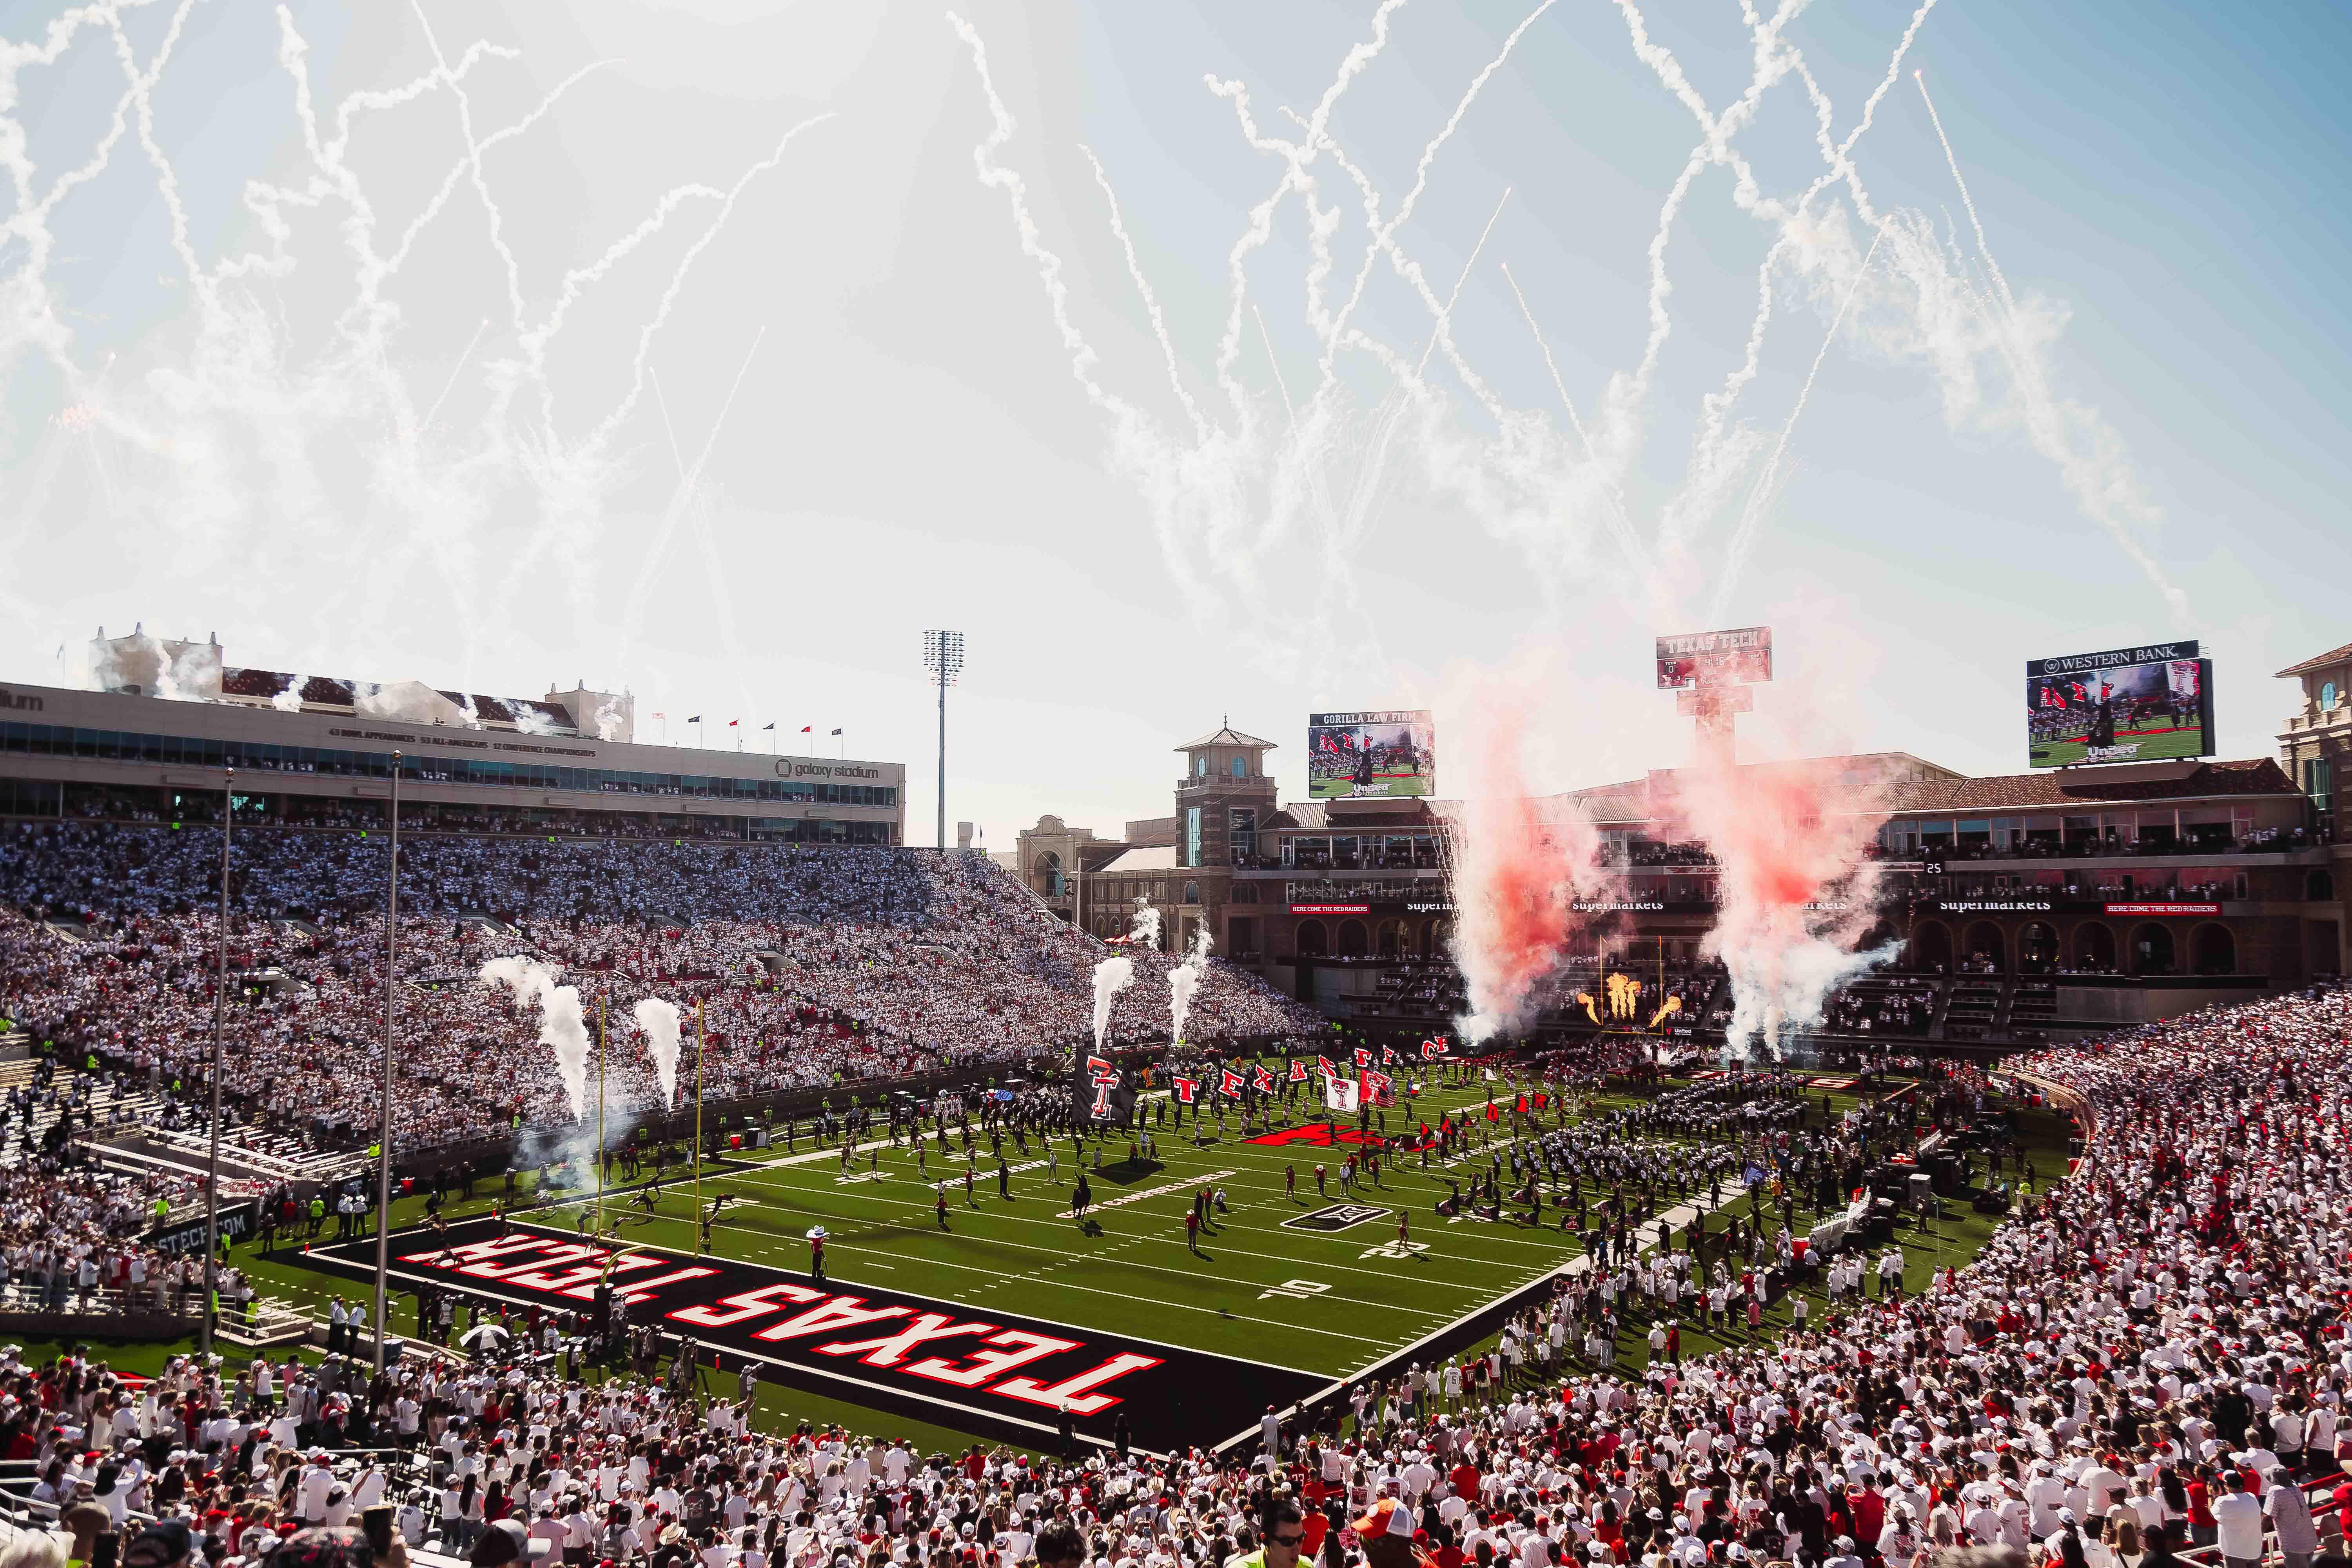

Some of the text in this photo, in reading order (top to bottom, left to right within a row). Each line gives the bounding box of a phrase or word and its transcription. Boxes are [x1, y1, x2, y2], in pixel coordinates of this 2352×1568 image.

[1666, 632, 1757, 654] TEXAS TECH
[2061, 646, 2176, 670] WESTERN BANK
[1324, 712, 1417, 724] GORILLA LAW FIRM
[503, 743, 543, 754] CONFERENCE
[544, 746, 596, 758] CHAMPIONSHIPS
[2088, 745, 2138, 758] United
[795, 763, 878, 779] galaxy stadium
[1927, 863, 1941, 873] 25
[1265, 1279, 1333, 1299] 10
[395, 1232, 1167, 1417] TEXAS TECH
